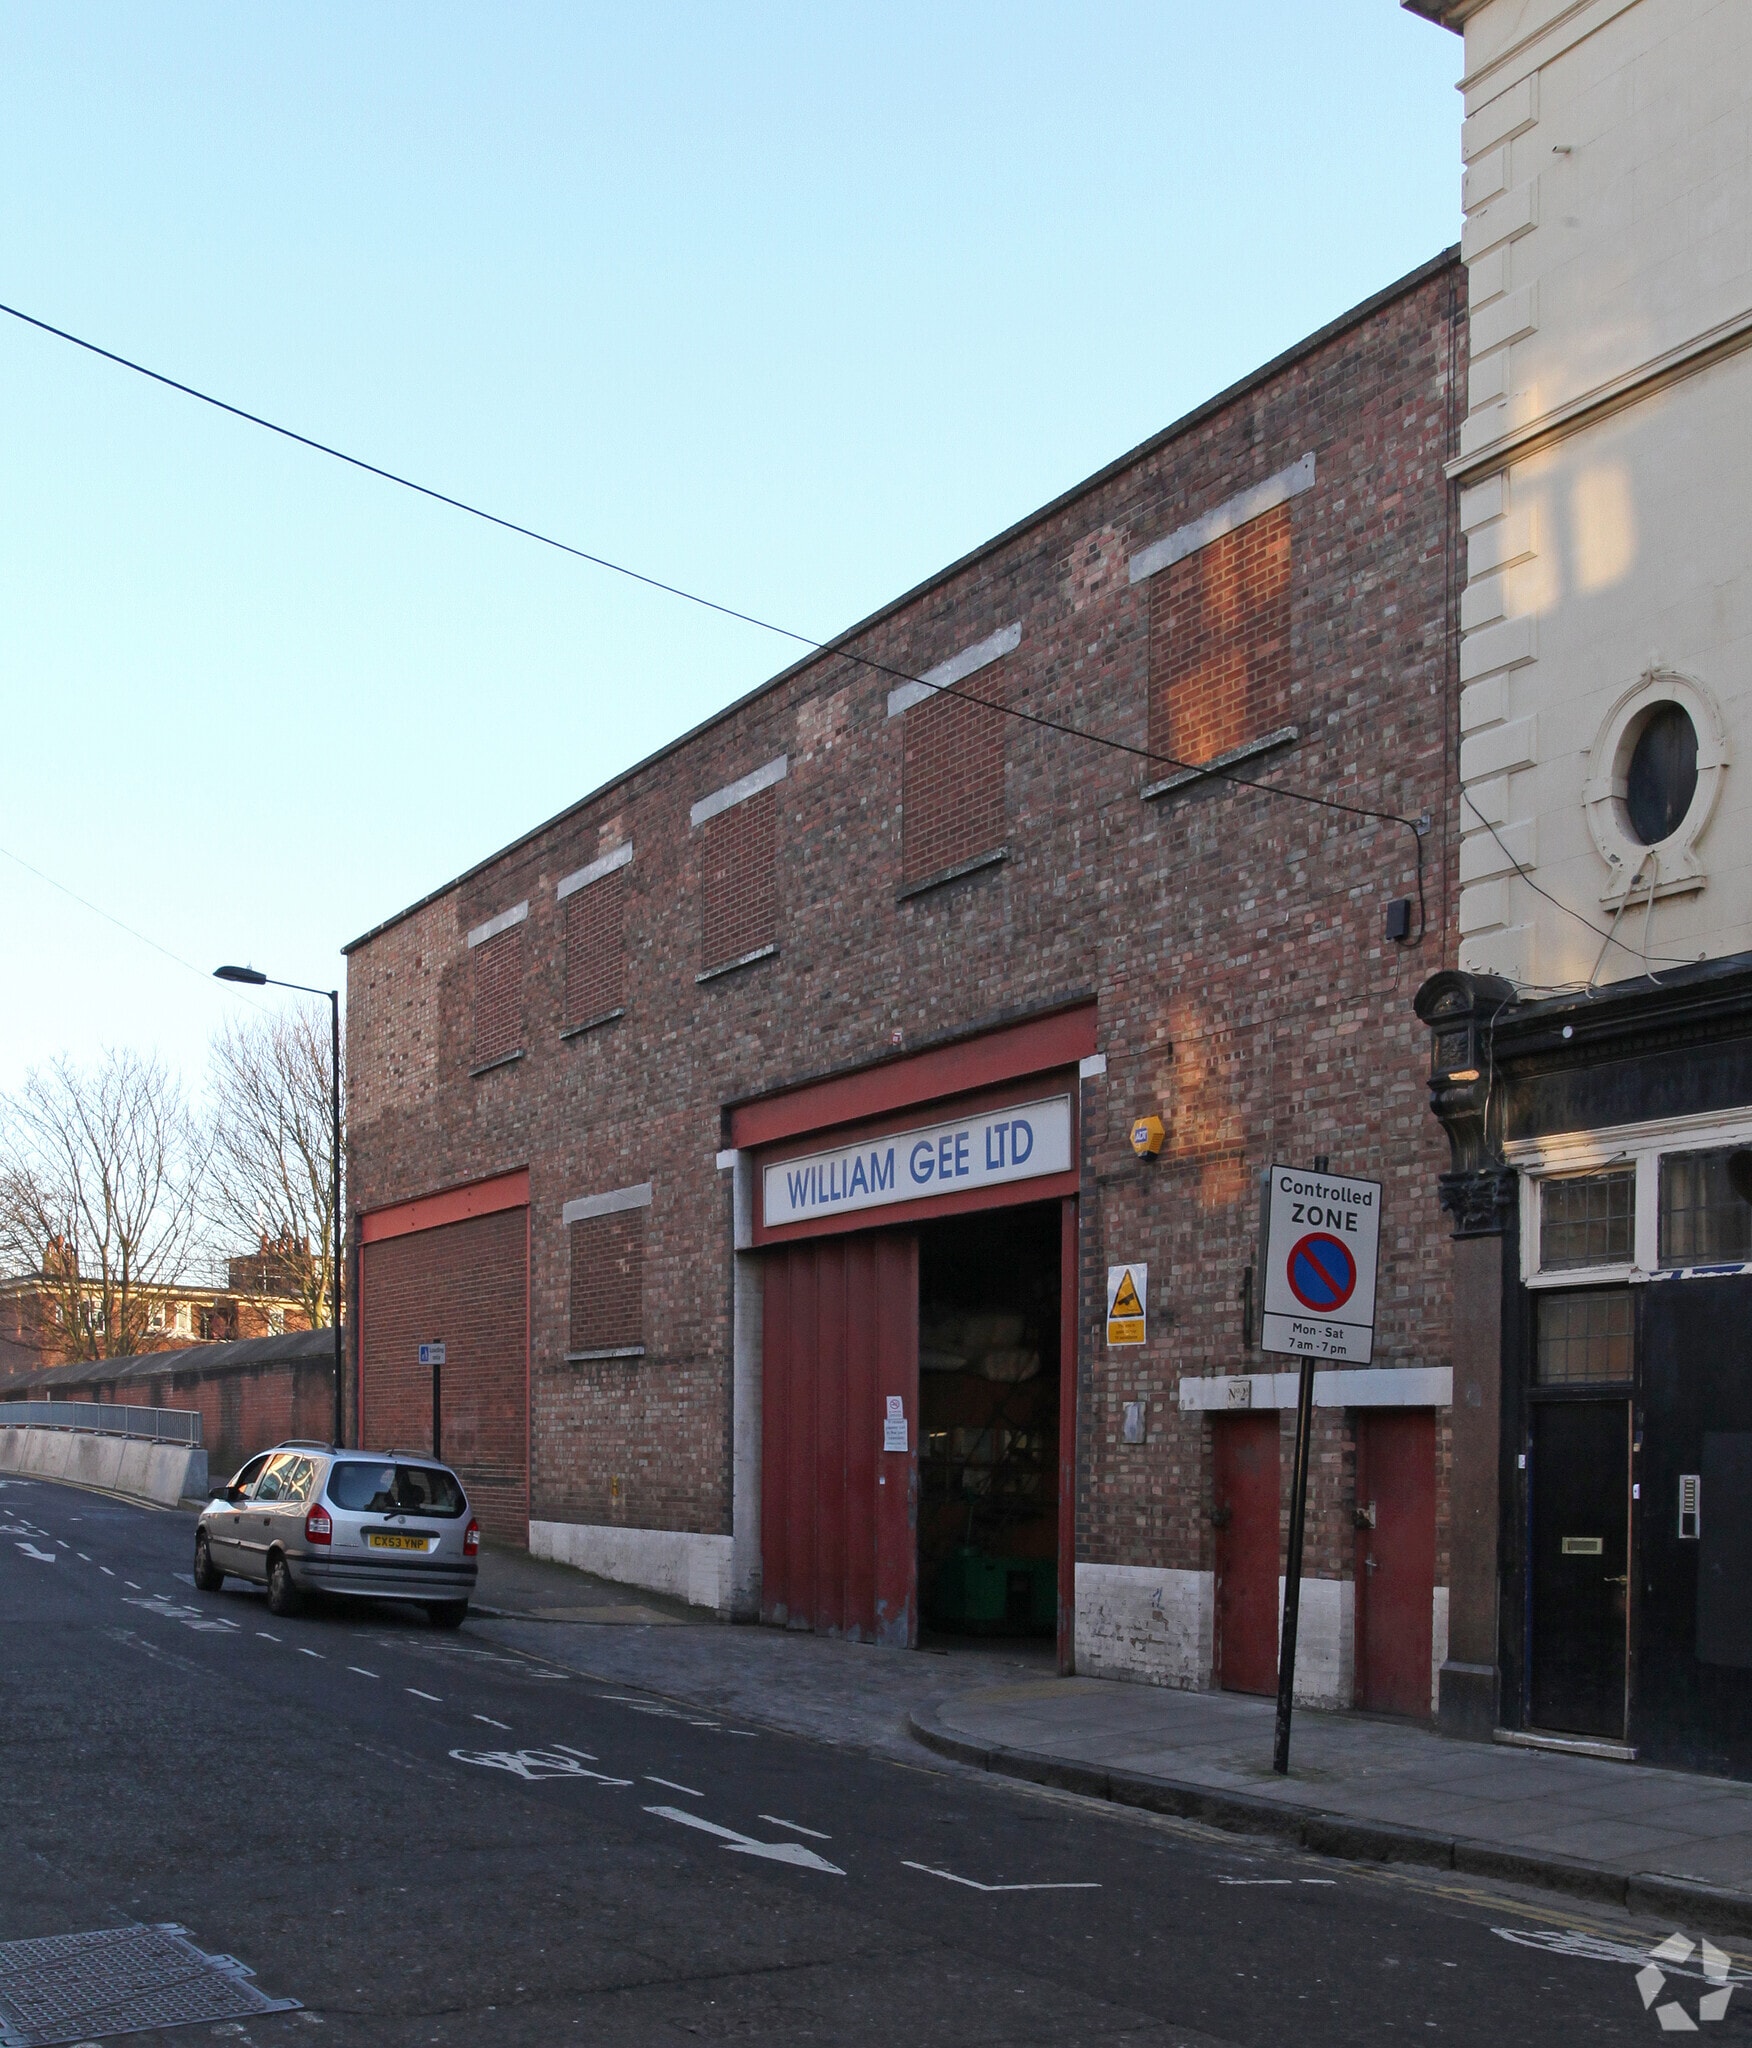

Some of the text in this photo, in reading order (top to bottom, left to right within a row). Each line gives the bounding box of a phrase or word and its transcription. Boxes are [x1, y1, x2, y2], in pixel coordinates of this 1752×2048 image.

[786, 1119, 1034, 1210] WILLIAM GEE LTD
[1280, 1176, 1373, 1207] Controlled
[1291, 1202, 1358, 1233] ZONE
[1292, 1322, 1316, 1336] Mon
[1324, 1327, 1345, 1339] Sat
[374, 1536, 424, 1549] CX53 YNP
